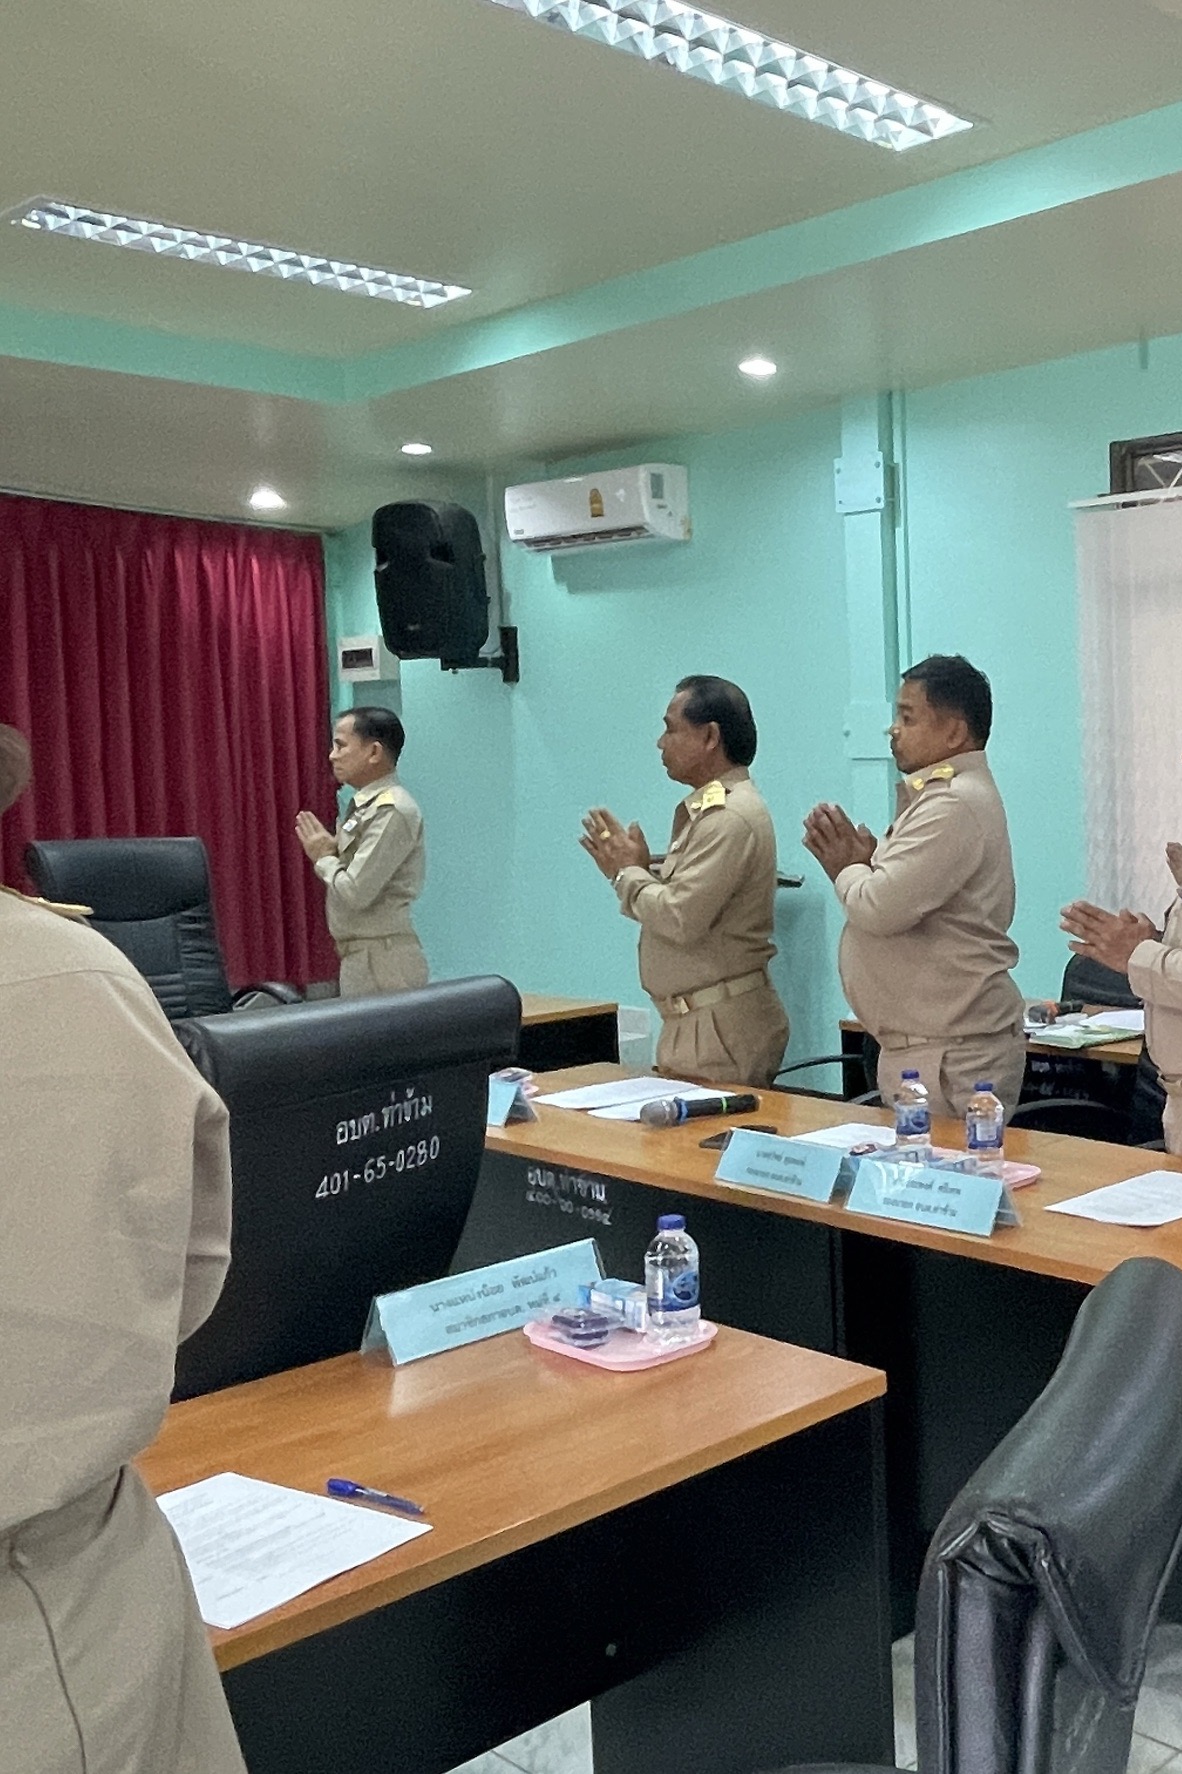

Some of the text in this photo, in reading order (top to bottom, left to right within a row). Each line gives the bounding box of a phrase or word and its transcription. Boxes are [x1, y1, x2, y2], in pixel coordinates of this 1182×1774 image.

[335, 1087, 433, 1145] อบต.ท่าข้าม
[314, 1134, 440, 1199] 401-65-0280
